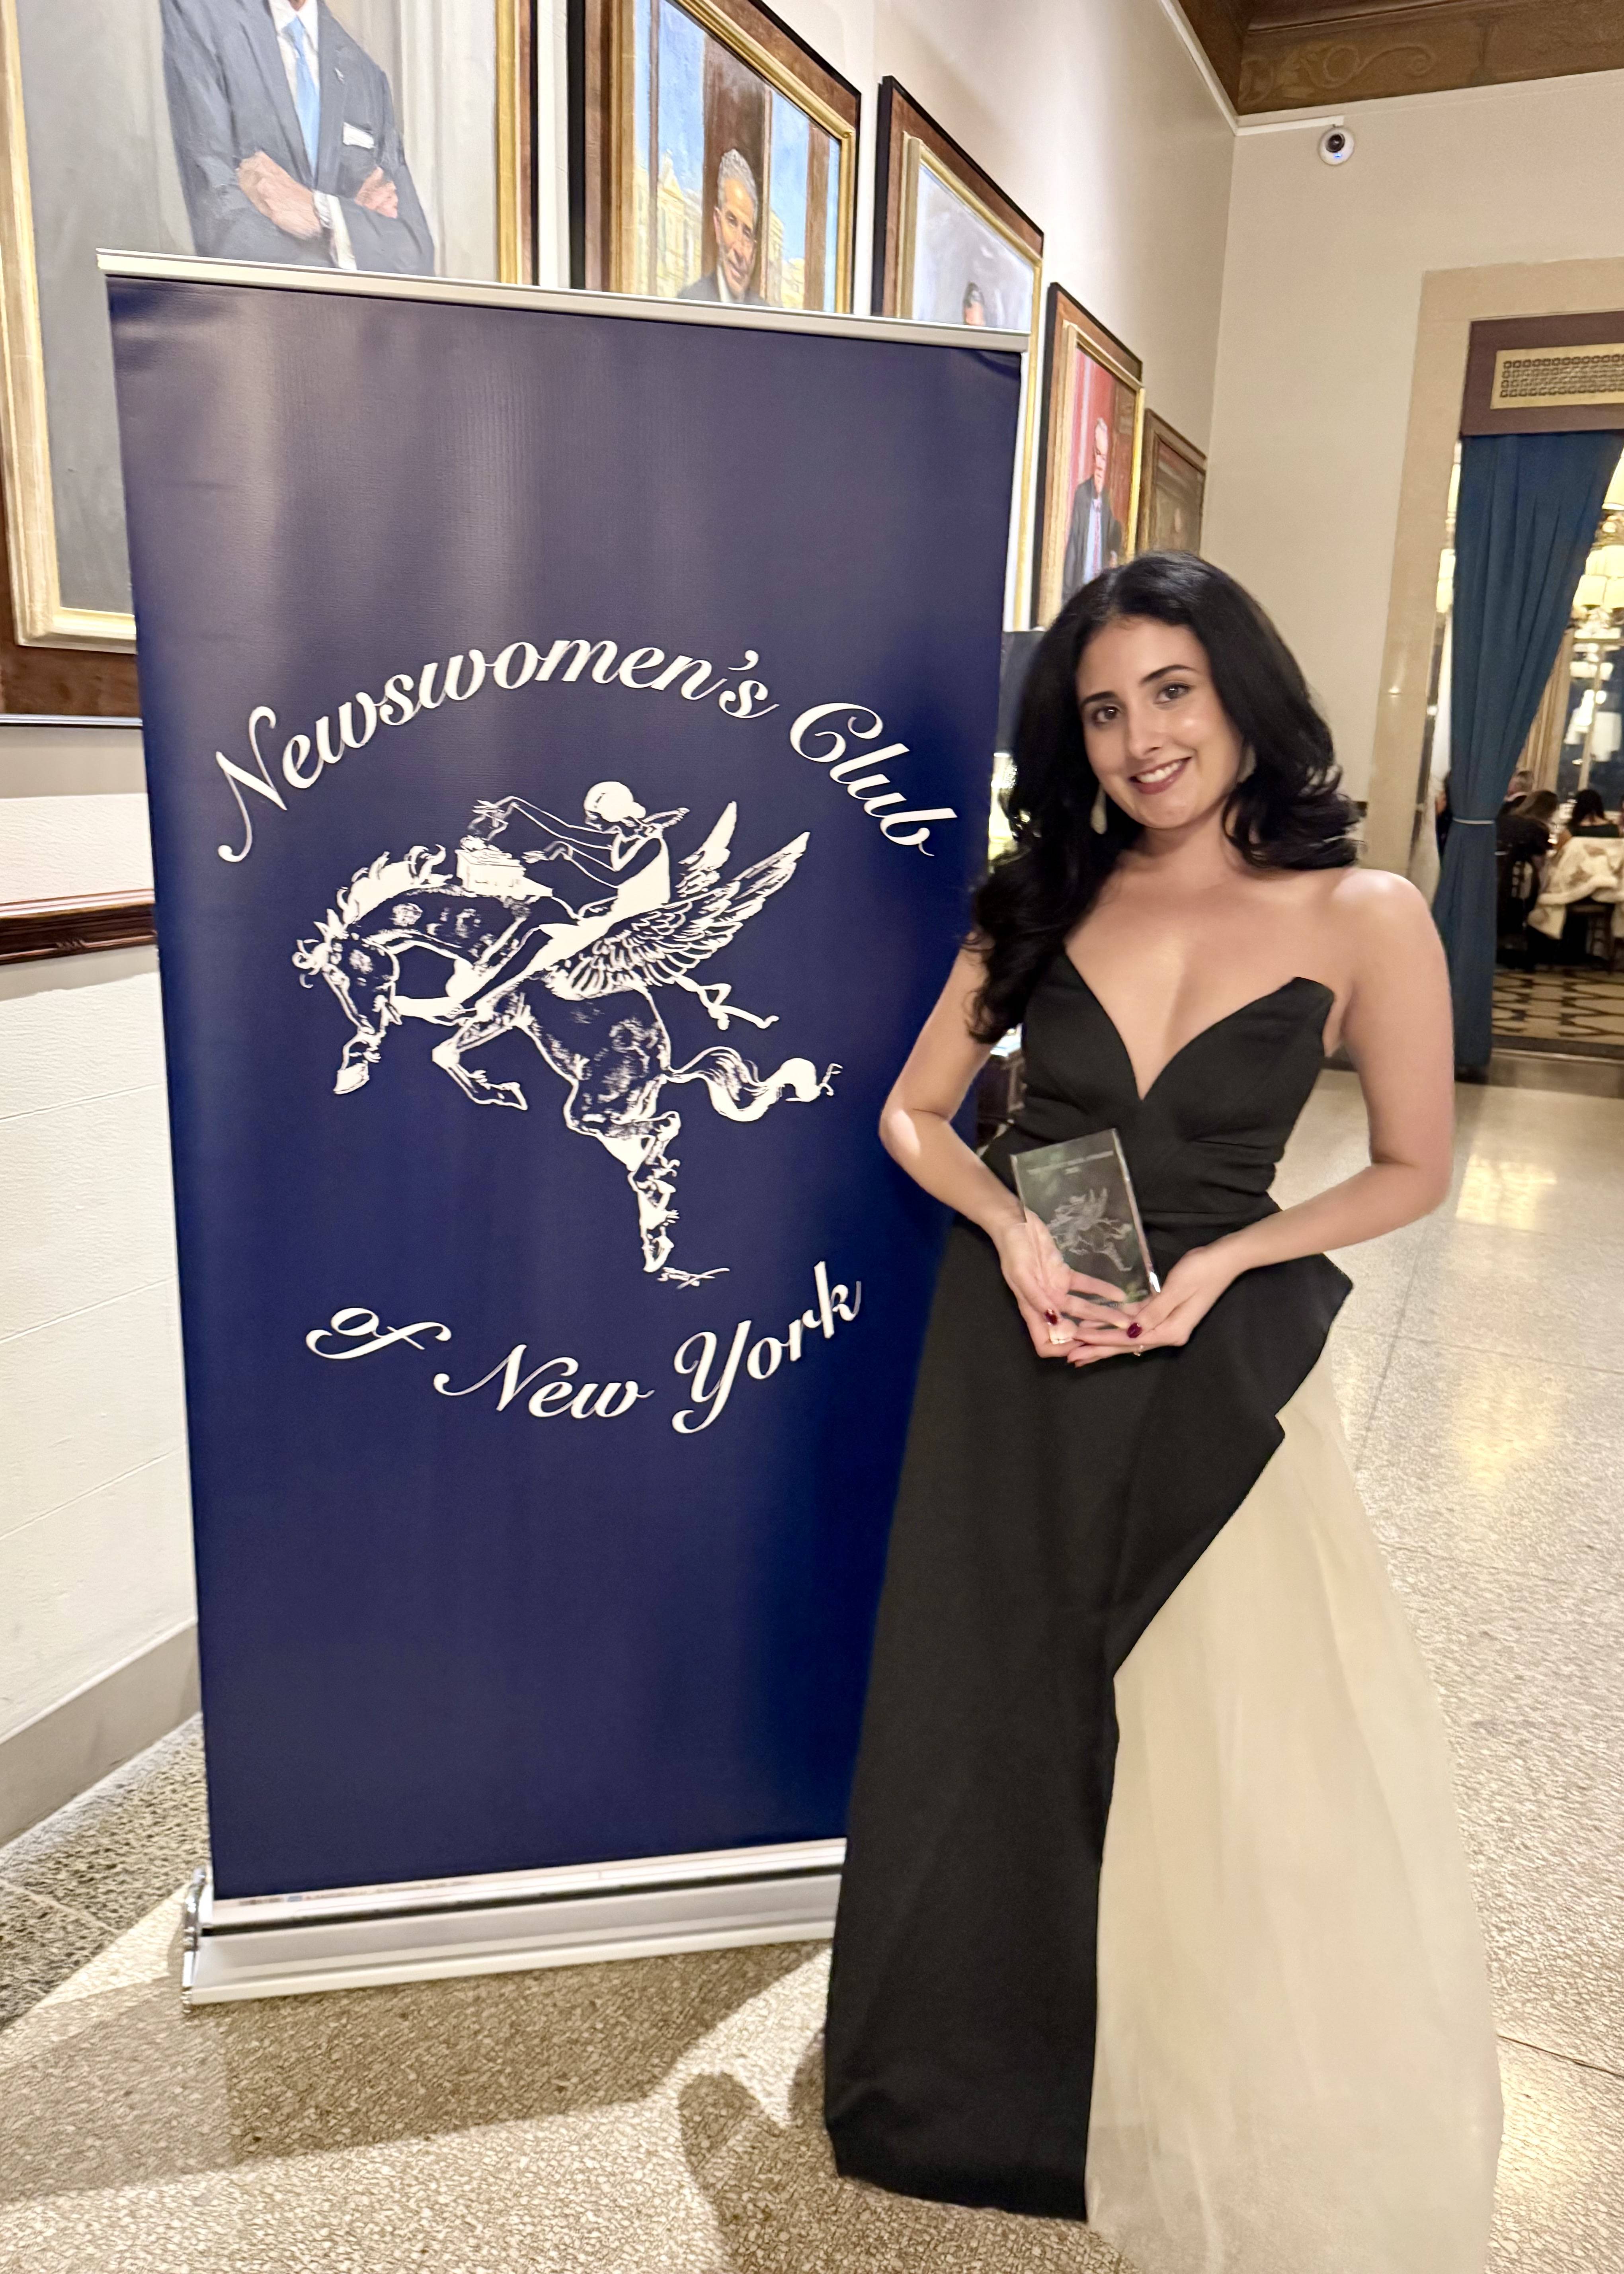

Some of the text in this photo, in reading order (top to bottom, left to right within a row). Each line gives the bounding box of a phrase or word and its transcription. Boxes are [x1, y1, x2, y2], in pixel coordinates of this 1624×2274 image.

[215, 639, 958, 863] Newswomen's Club
[306, 1261, 861, 1434] of New York
